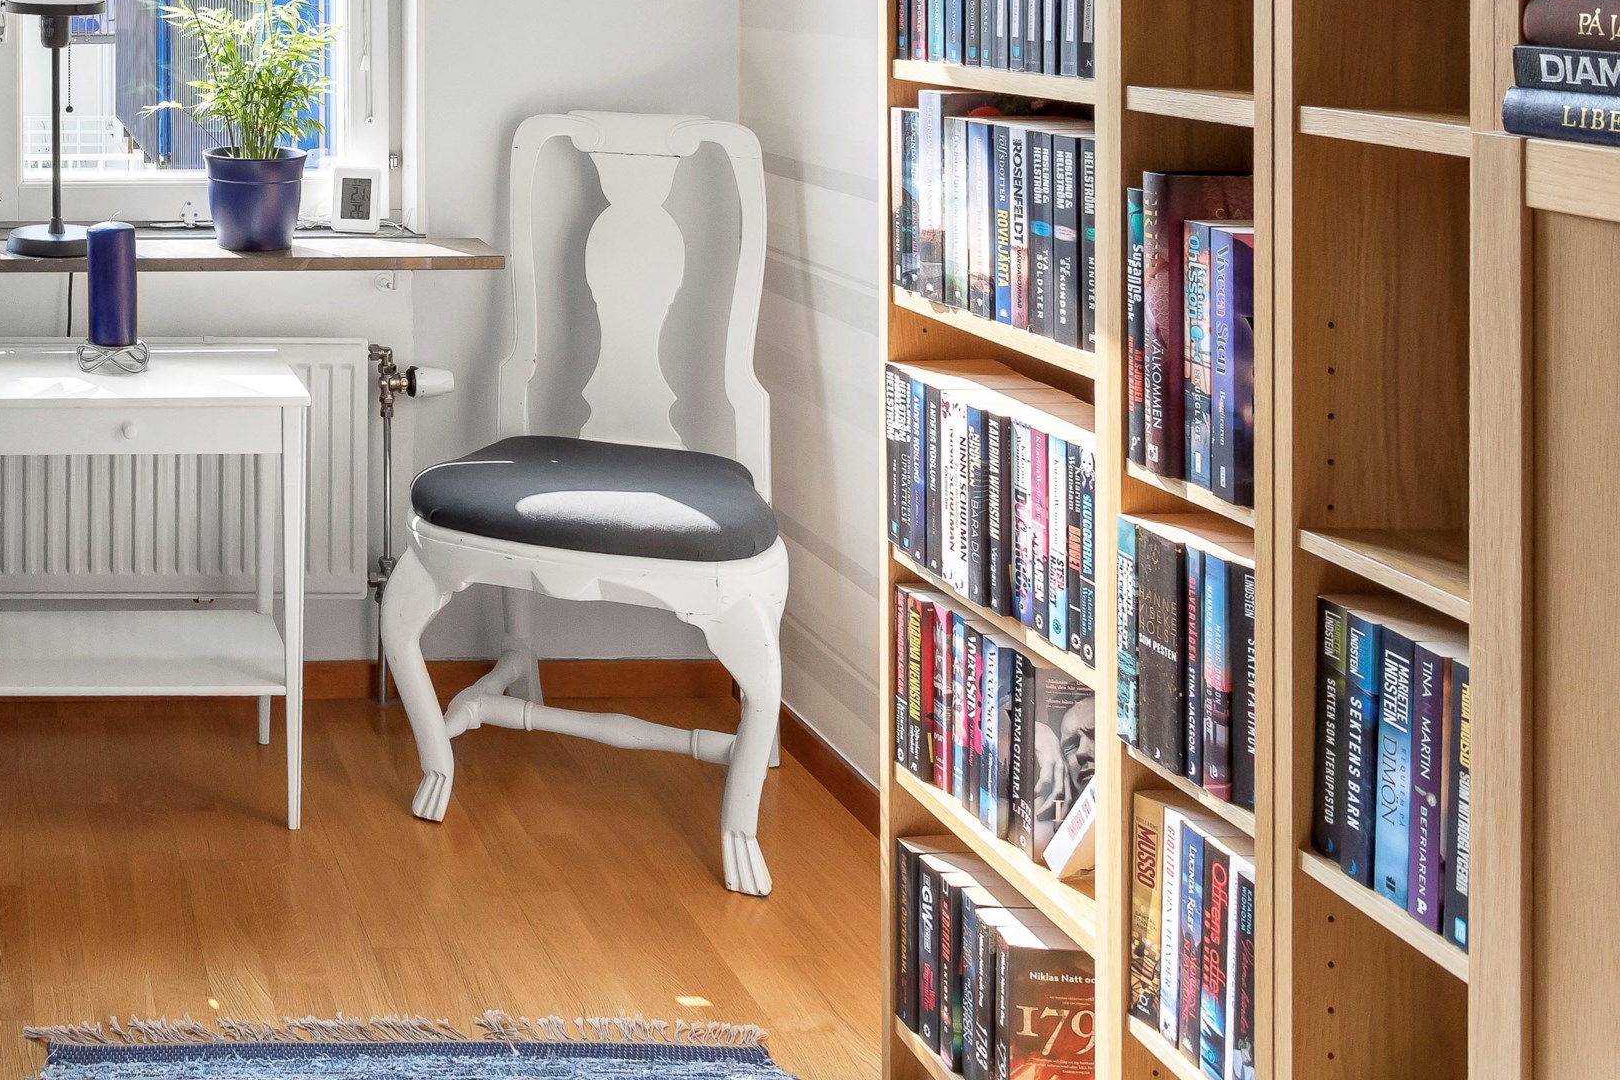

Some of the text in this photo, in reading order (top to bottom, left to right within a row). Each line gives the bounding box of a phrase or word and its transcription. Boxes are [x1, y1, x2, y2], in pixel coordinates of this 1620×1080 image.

[1578, 8, 1605, 36] PÅ
[1561, 105, 1620, 132] LIBE
[1013, 142, 1024, 244] ROSENFELDT
[1034, 146, 1042, 204] HELLSTRÖM
[1042, 148, 1050, 194] ROSLUND
[1056, 150, 1066, 209] HELLSTRÖM
[1064, 151, 1073, 199] ROSLUND
[1084, 151, 1094, 214] HELLSTRÖM
[997, 209, 1010, 288] ROVHJÄRTA
[1131, 244, 1144, 302] Susanne
[1188, 235, 1199, 319] Ohlsson
[1196, 262, 1207, 319] Kristina
[1216, 243, 1229, 375] Viveca Sten
[886, 371, 895, 440] HELLSTRÖM
[1151, 338, 1162, 429] VÄLKOMMEN
[1194, 369, 1202, 440] SKUGGLÄGE
[968, 425, 976, 487] SCHULMAN
[989, 419, 1000, 540] KATARINA WENNSTAM
[971, 498, 980, 563] BARA DU
[1082, 494, 1093, 574] SKUGGORNA
[1056, 558, 1065, 590] STEN
[1245, 574, 1255, 618] LINDSTEIN
[1152, 640, 1178, 662] PESTEN
[1188, 576, 1197, 662] SILVERVÄGEN
[1324, 612, 1335, 657] LINDSTEIN
[909, 610, 921, 721] KATARINA WENNSTAM
[1350, 631, 1360, 675] LINDSTEIN
[1383, 651, 1397, 725] LINDSTEIN
[1395, 663, 1409, 724] MARIETTE
[1419, 661, 1433, 779] TINA MARTIN
[1012, 655, 1023, 799] HANYA YANAGIHARA
[1324, 678, 1337, 825] SEKTEN SOM ÅTERUPPSTOD
[1347, 696, 1362, 830] SEKTENS BARN
[1381, 735, 1400, 827] DIMÖN
[1399, 747, 1407, 808] REQUIEM
[1137, 823, 1157, 890] MUSSO
[1166, 825, 1175, 877] GIOLITO
[1417, 804, 1429, 896] BEFRIAREN
[922, 885, 933, 930] GW
[1187, 844, 1197, 932] LUCINDA RILEY
[1209, 862, 1228, 1003] Offrens offer
[1029, 971, 1083, 984] Niklas Natt
[976, 1020, 988, 1070] 1793
[1016, 1004, 1095, 1056] 179
